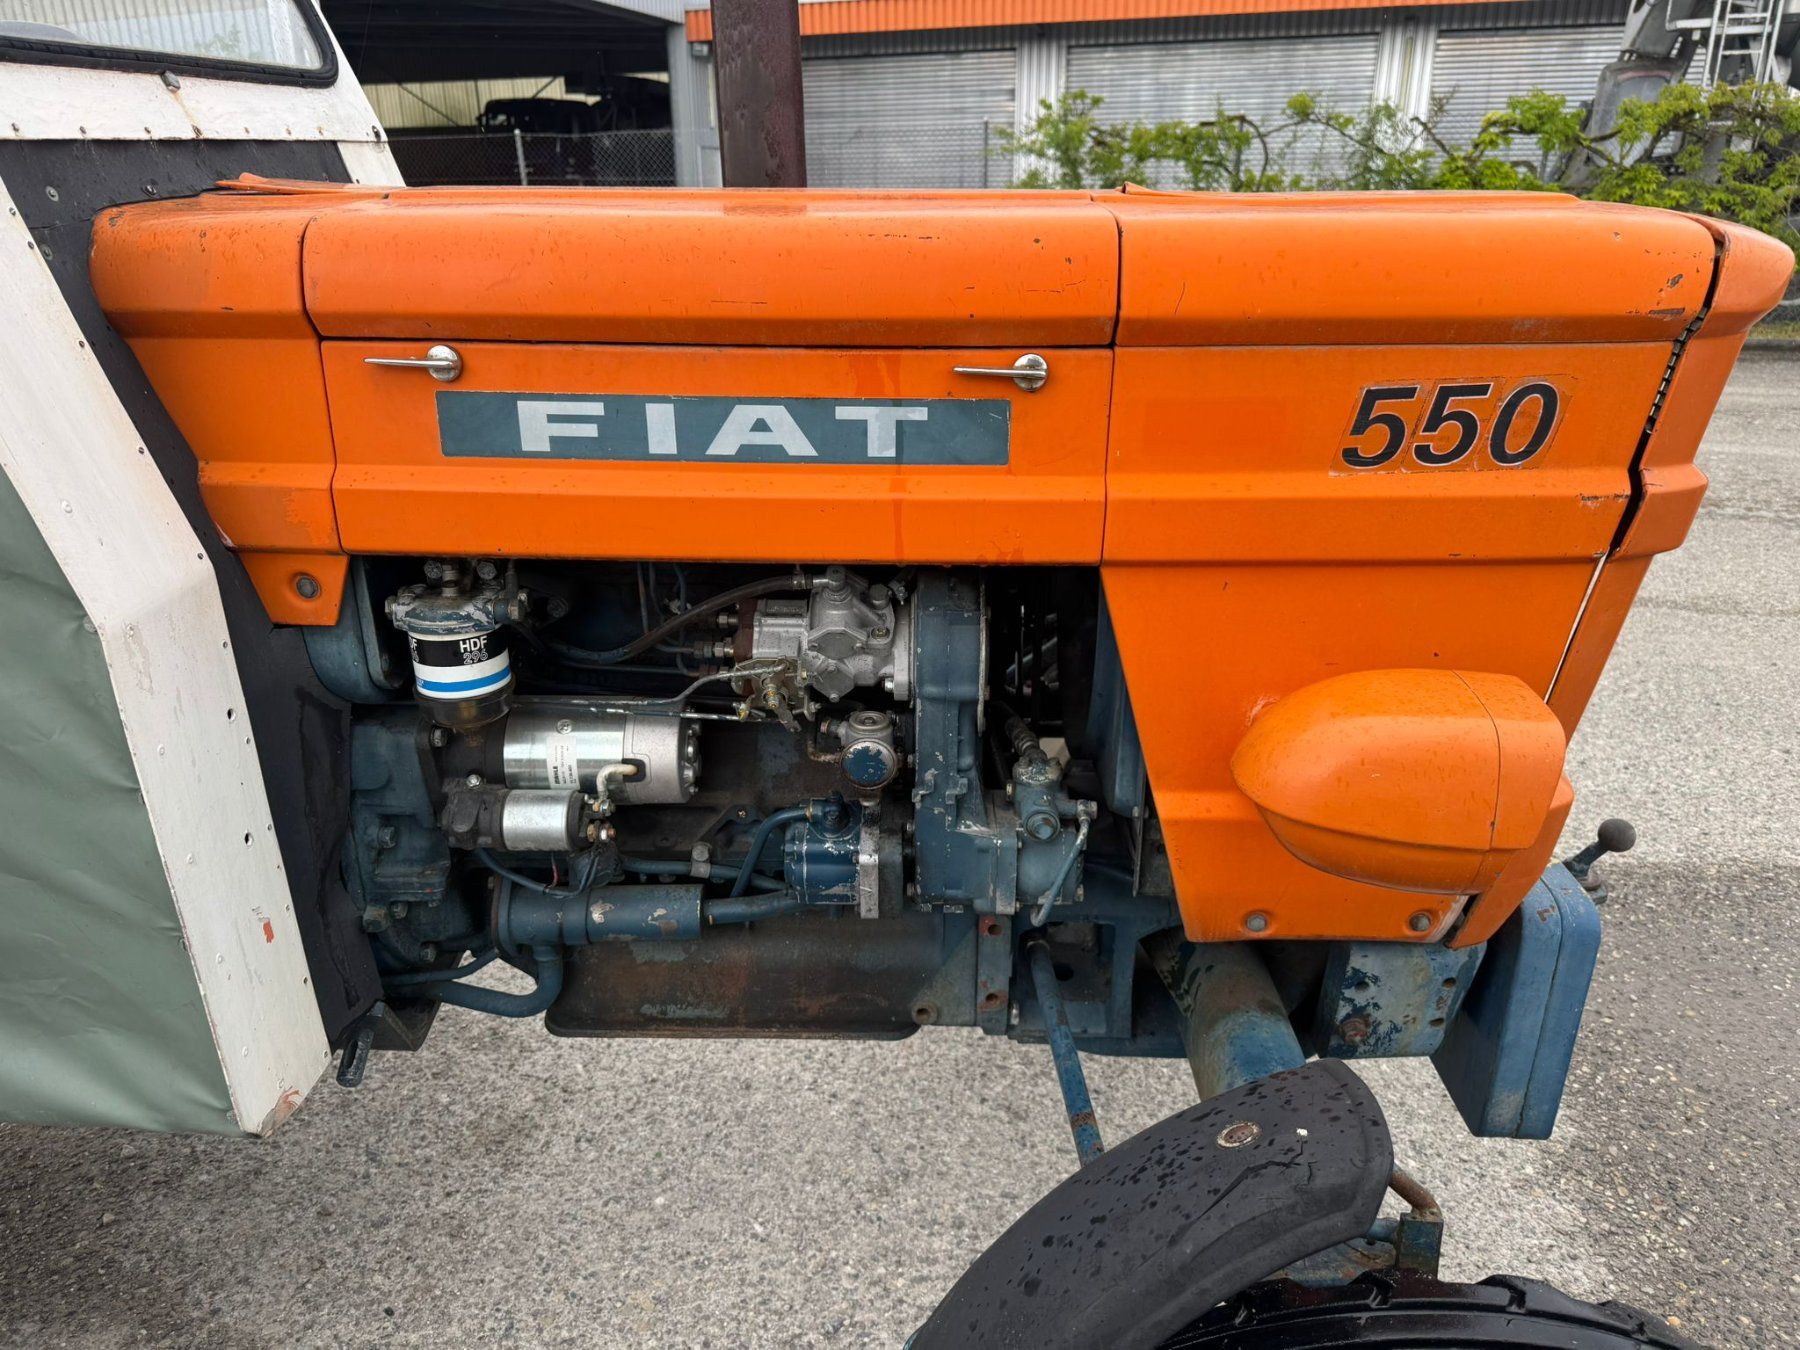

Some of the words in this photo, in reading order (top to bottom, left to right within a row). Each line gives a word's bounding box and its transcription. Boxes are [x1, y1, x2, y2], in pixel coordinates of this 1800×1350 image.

[516, 400, 928, 458] FIAT
[1341, 381, 1560, 470] 550
[459, 635, 488, 653] HDF
[463, 648, 488, 664] 296
